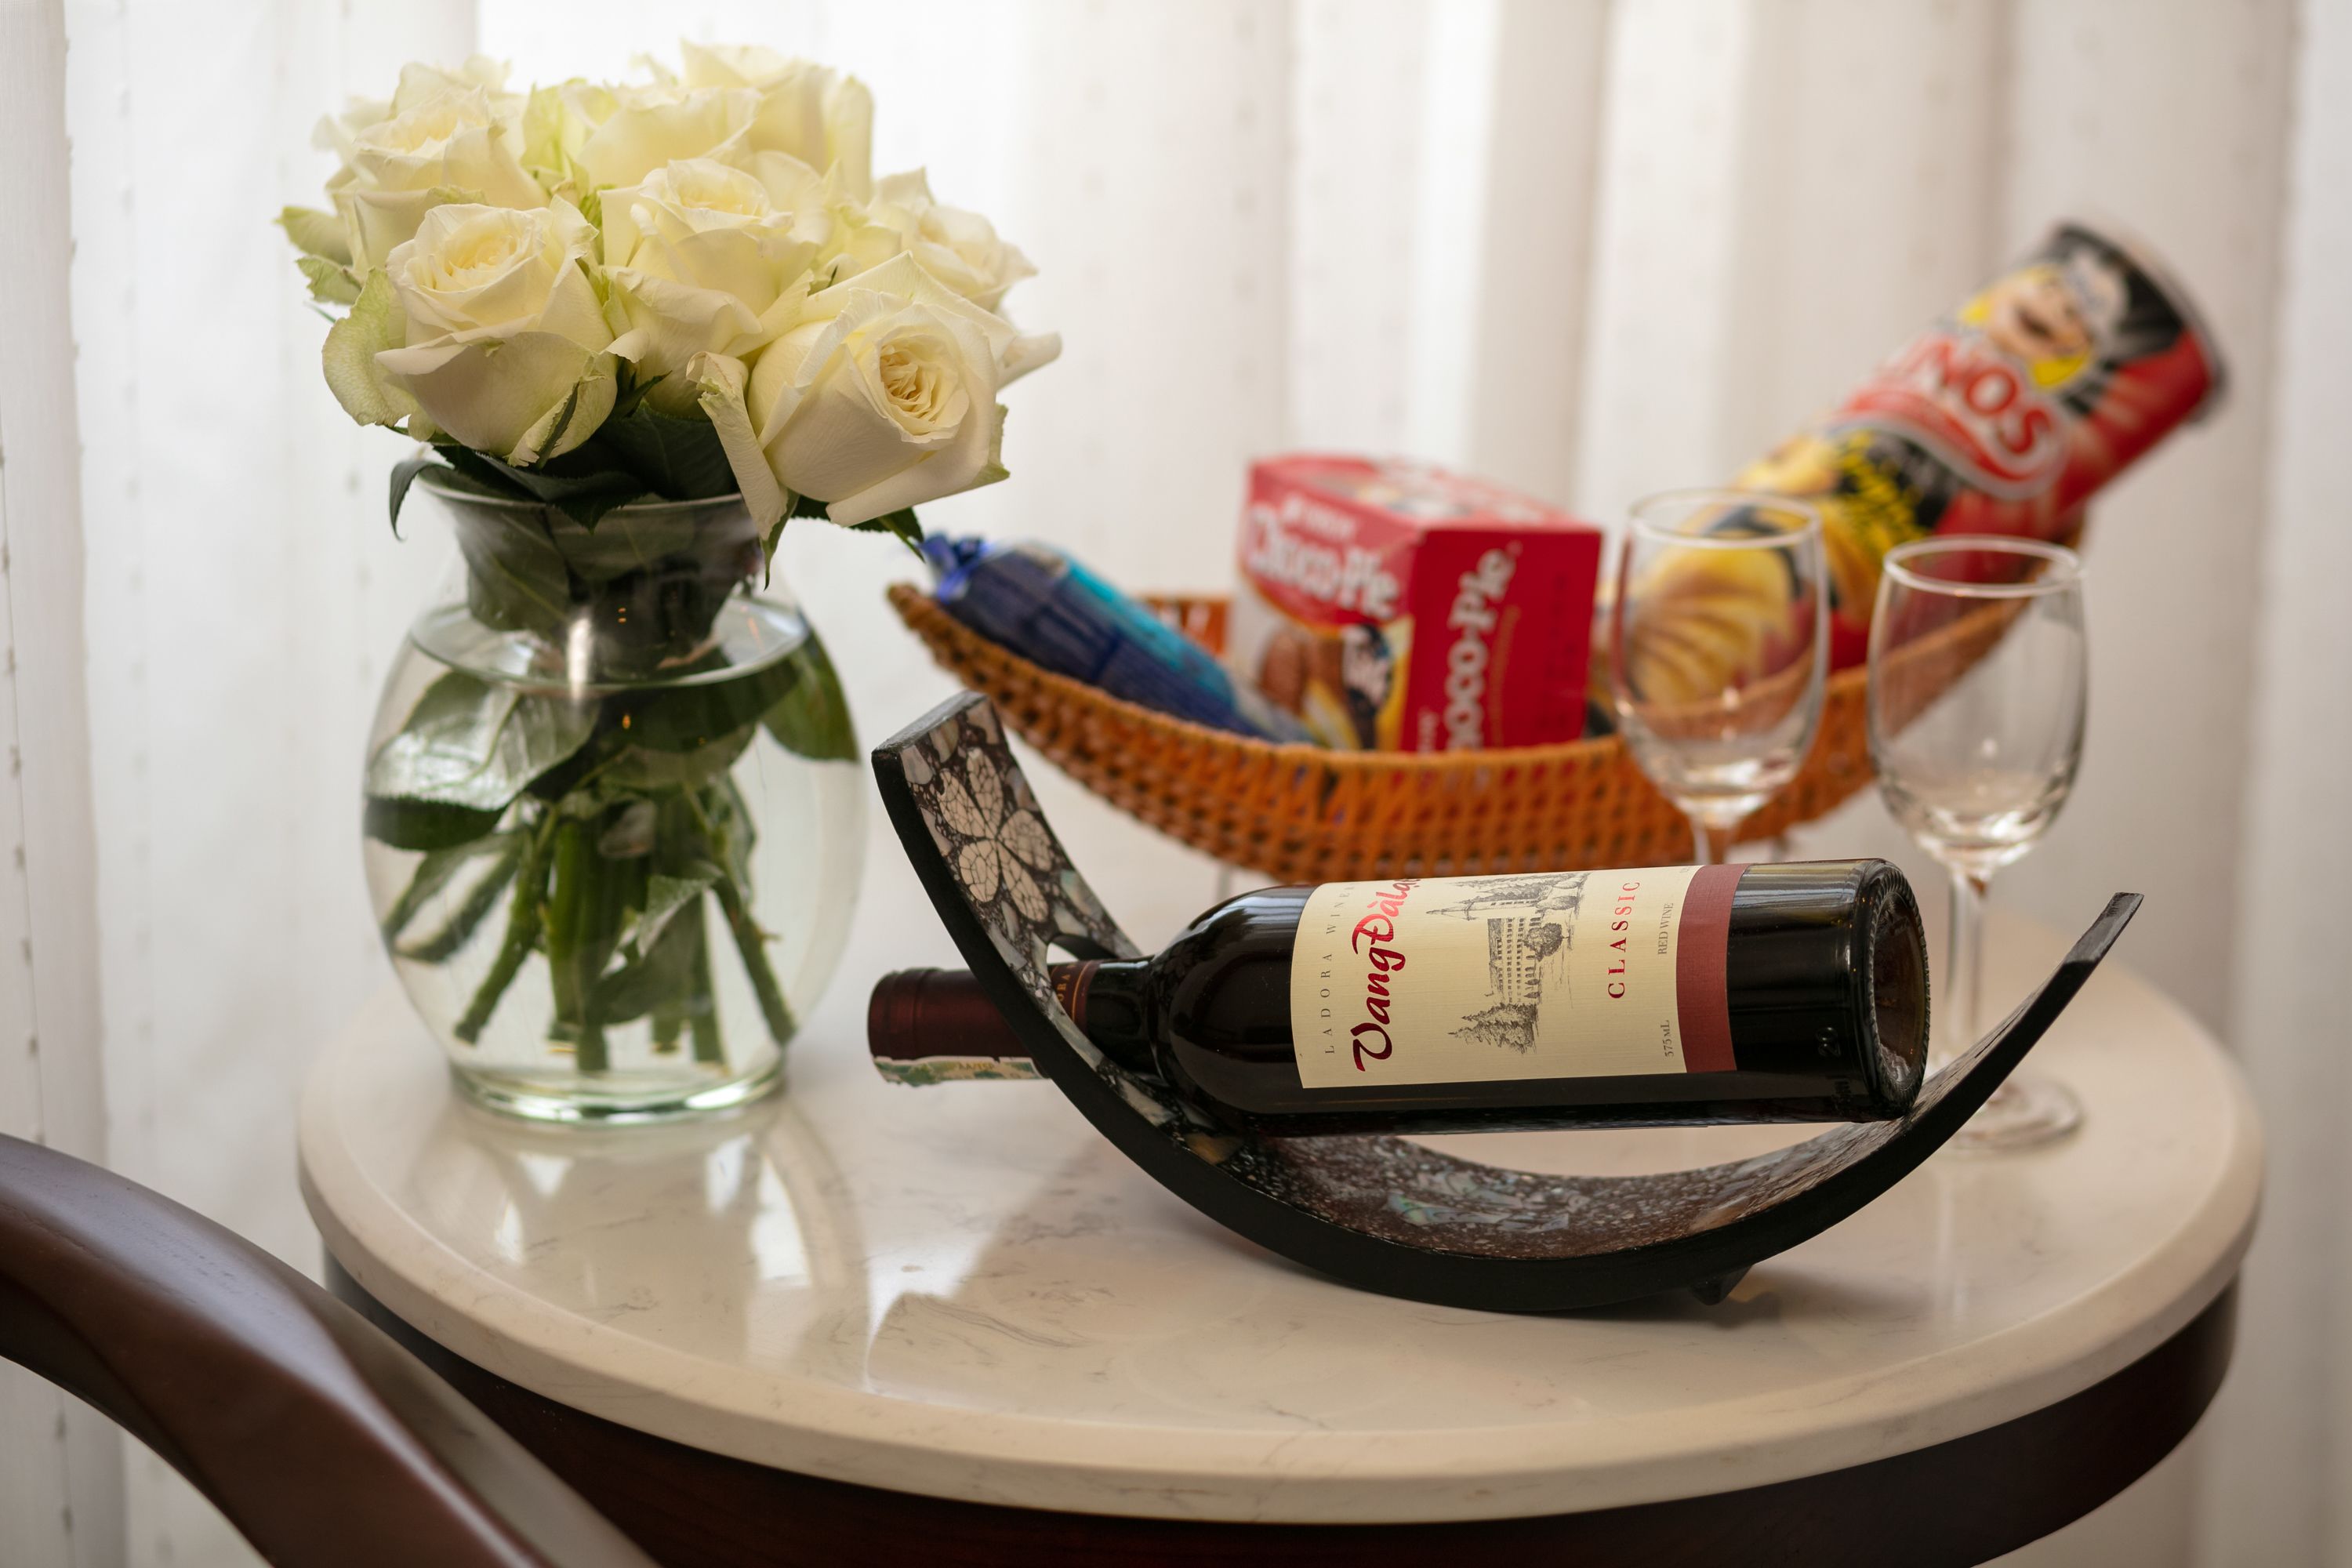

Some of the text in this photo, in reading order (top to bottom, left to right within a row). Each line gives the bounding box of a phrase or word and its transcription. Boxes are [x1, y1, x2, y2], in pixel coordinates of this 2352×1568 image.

[1607, 881, 1640, 999] CLASSIC
[1657, 902, 1674, 955] RED WINE
[1320, 953, 1334, 1054] LADORA
